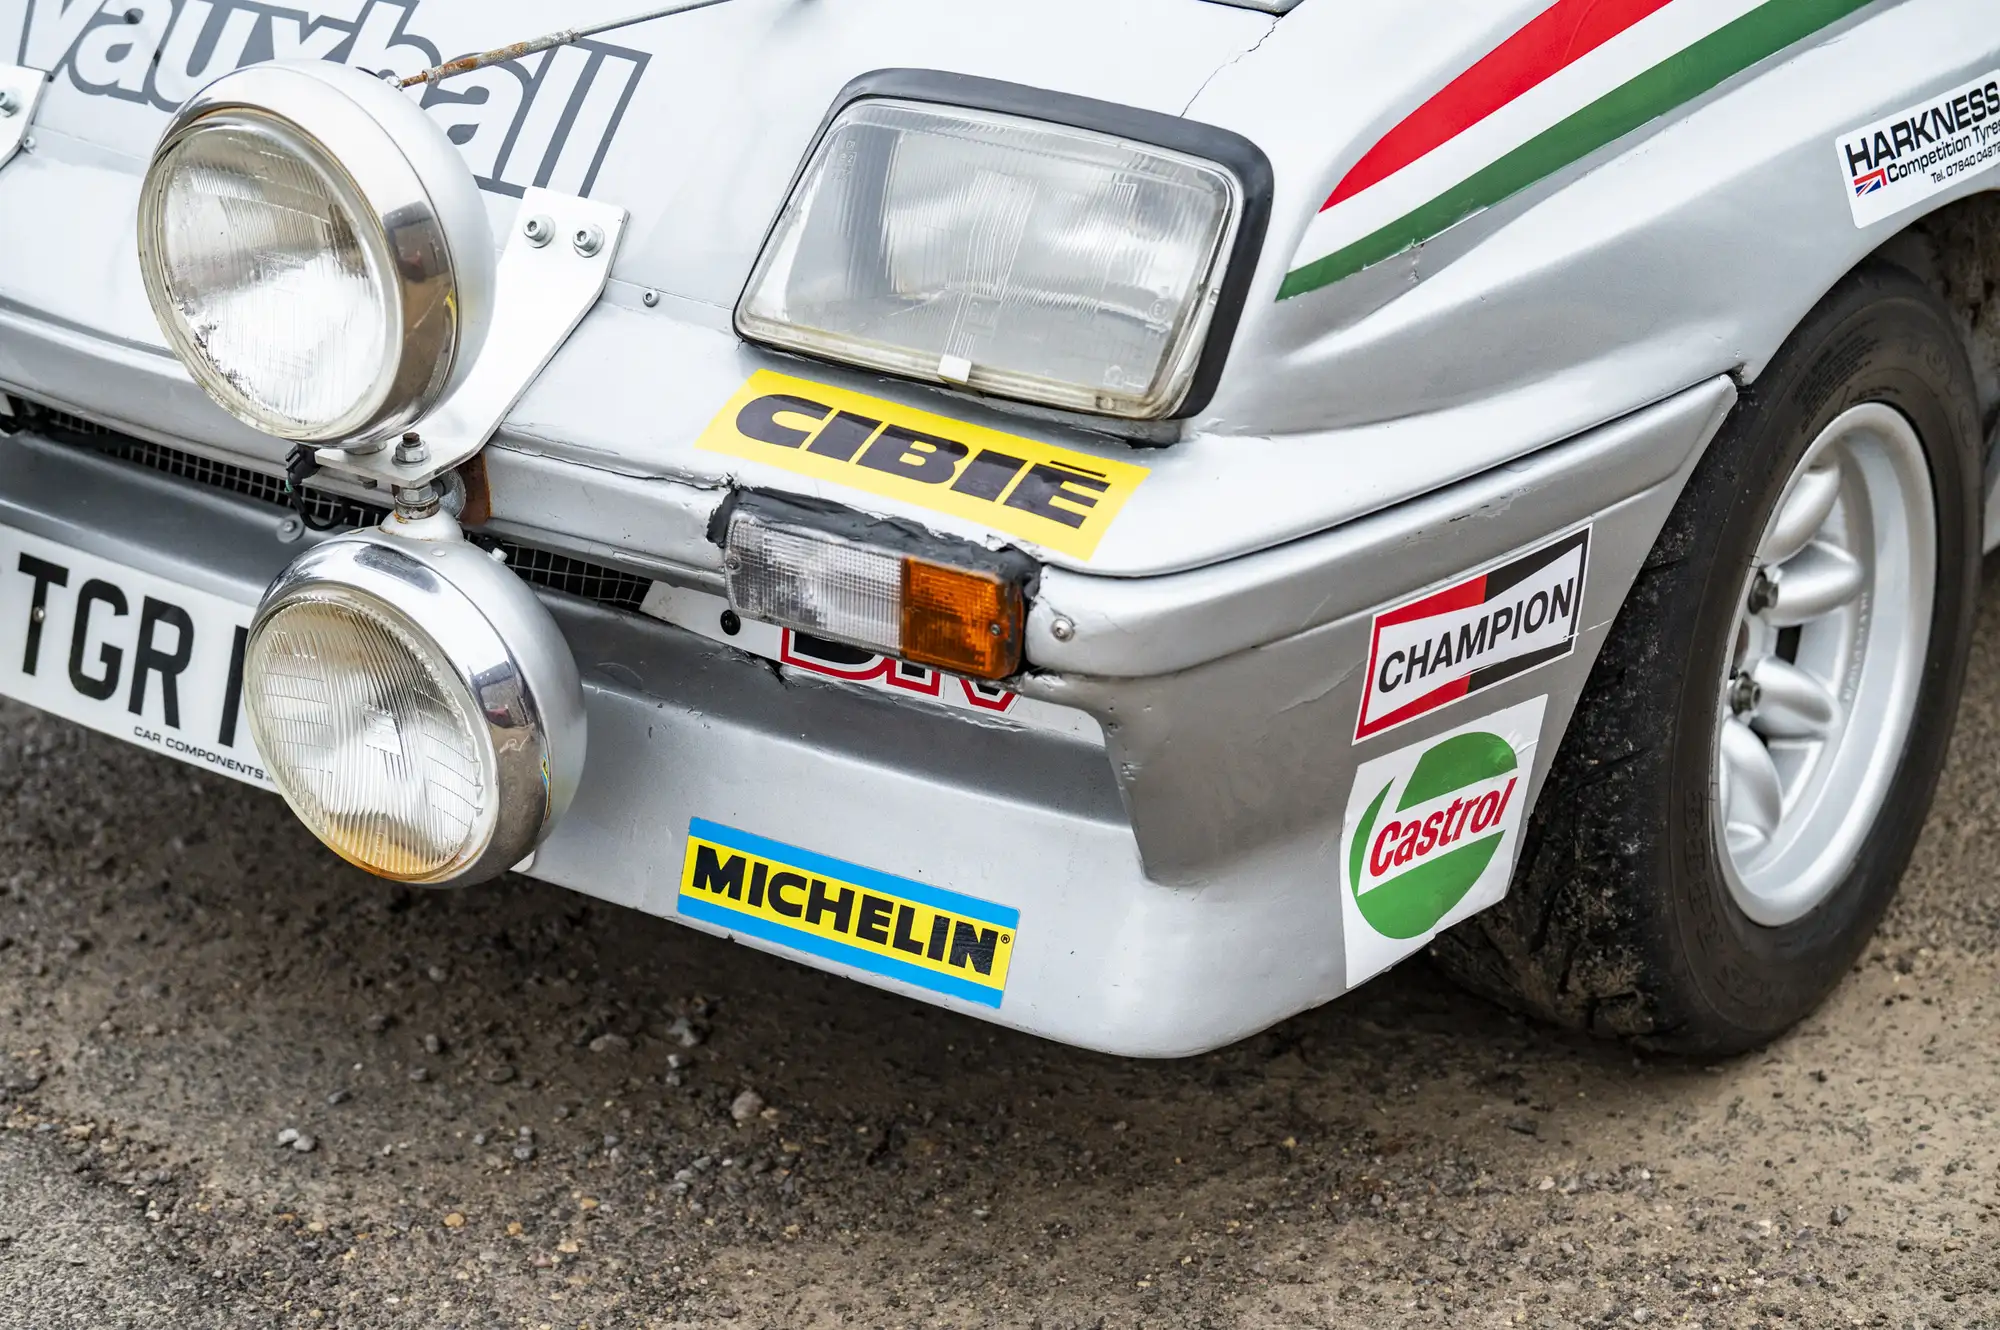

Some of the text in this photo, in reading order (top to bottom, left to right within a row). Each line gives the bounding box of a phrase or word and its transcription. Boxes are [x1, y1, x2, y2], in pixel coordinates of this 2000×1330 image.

[1845, 81, 2000, 177] HARKNESS
[1887, 135, 1972, 183] Competition
[1931, 169, 1946, 184] Tel.
[1946, 154, 1976, 177] 07840
[18, 551, 194, 729] TGR
[1378, 577, 1575, 693] CHAMPION
[133, 726, 265, 780] CAR COMPONENTS
[1369, 776, 1517, 877] Castrol
